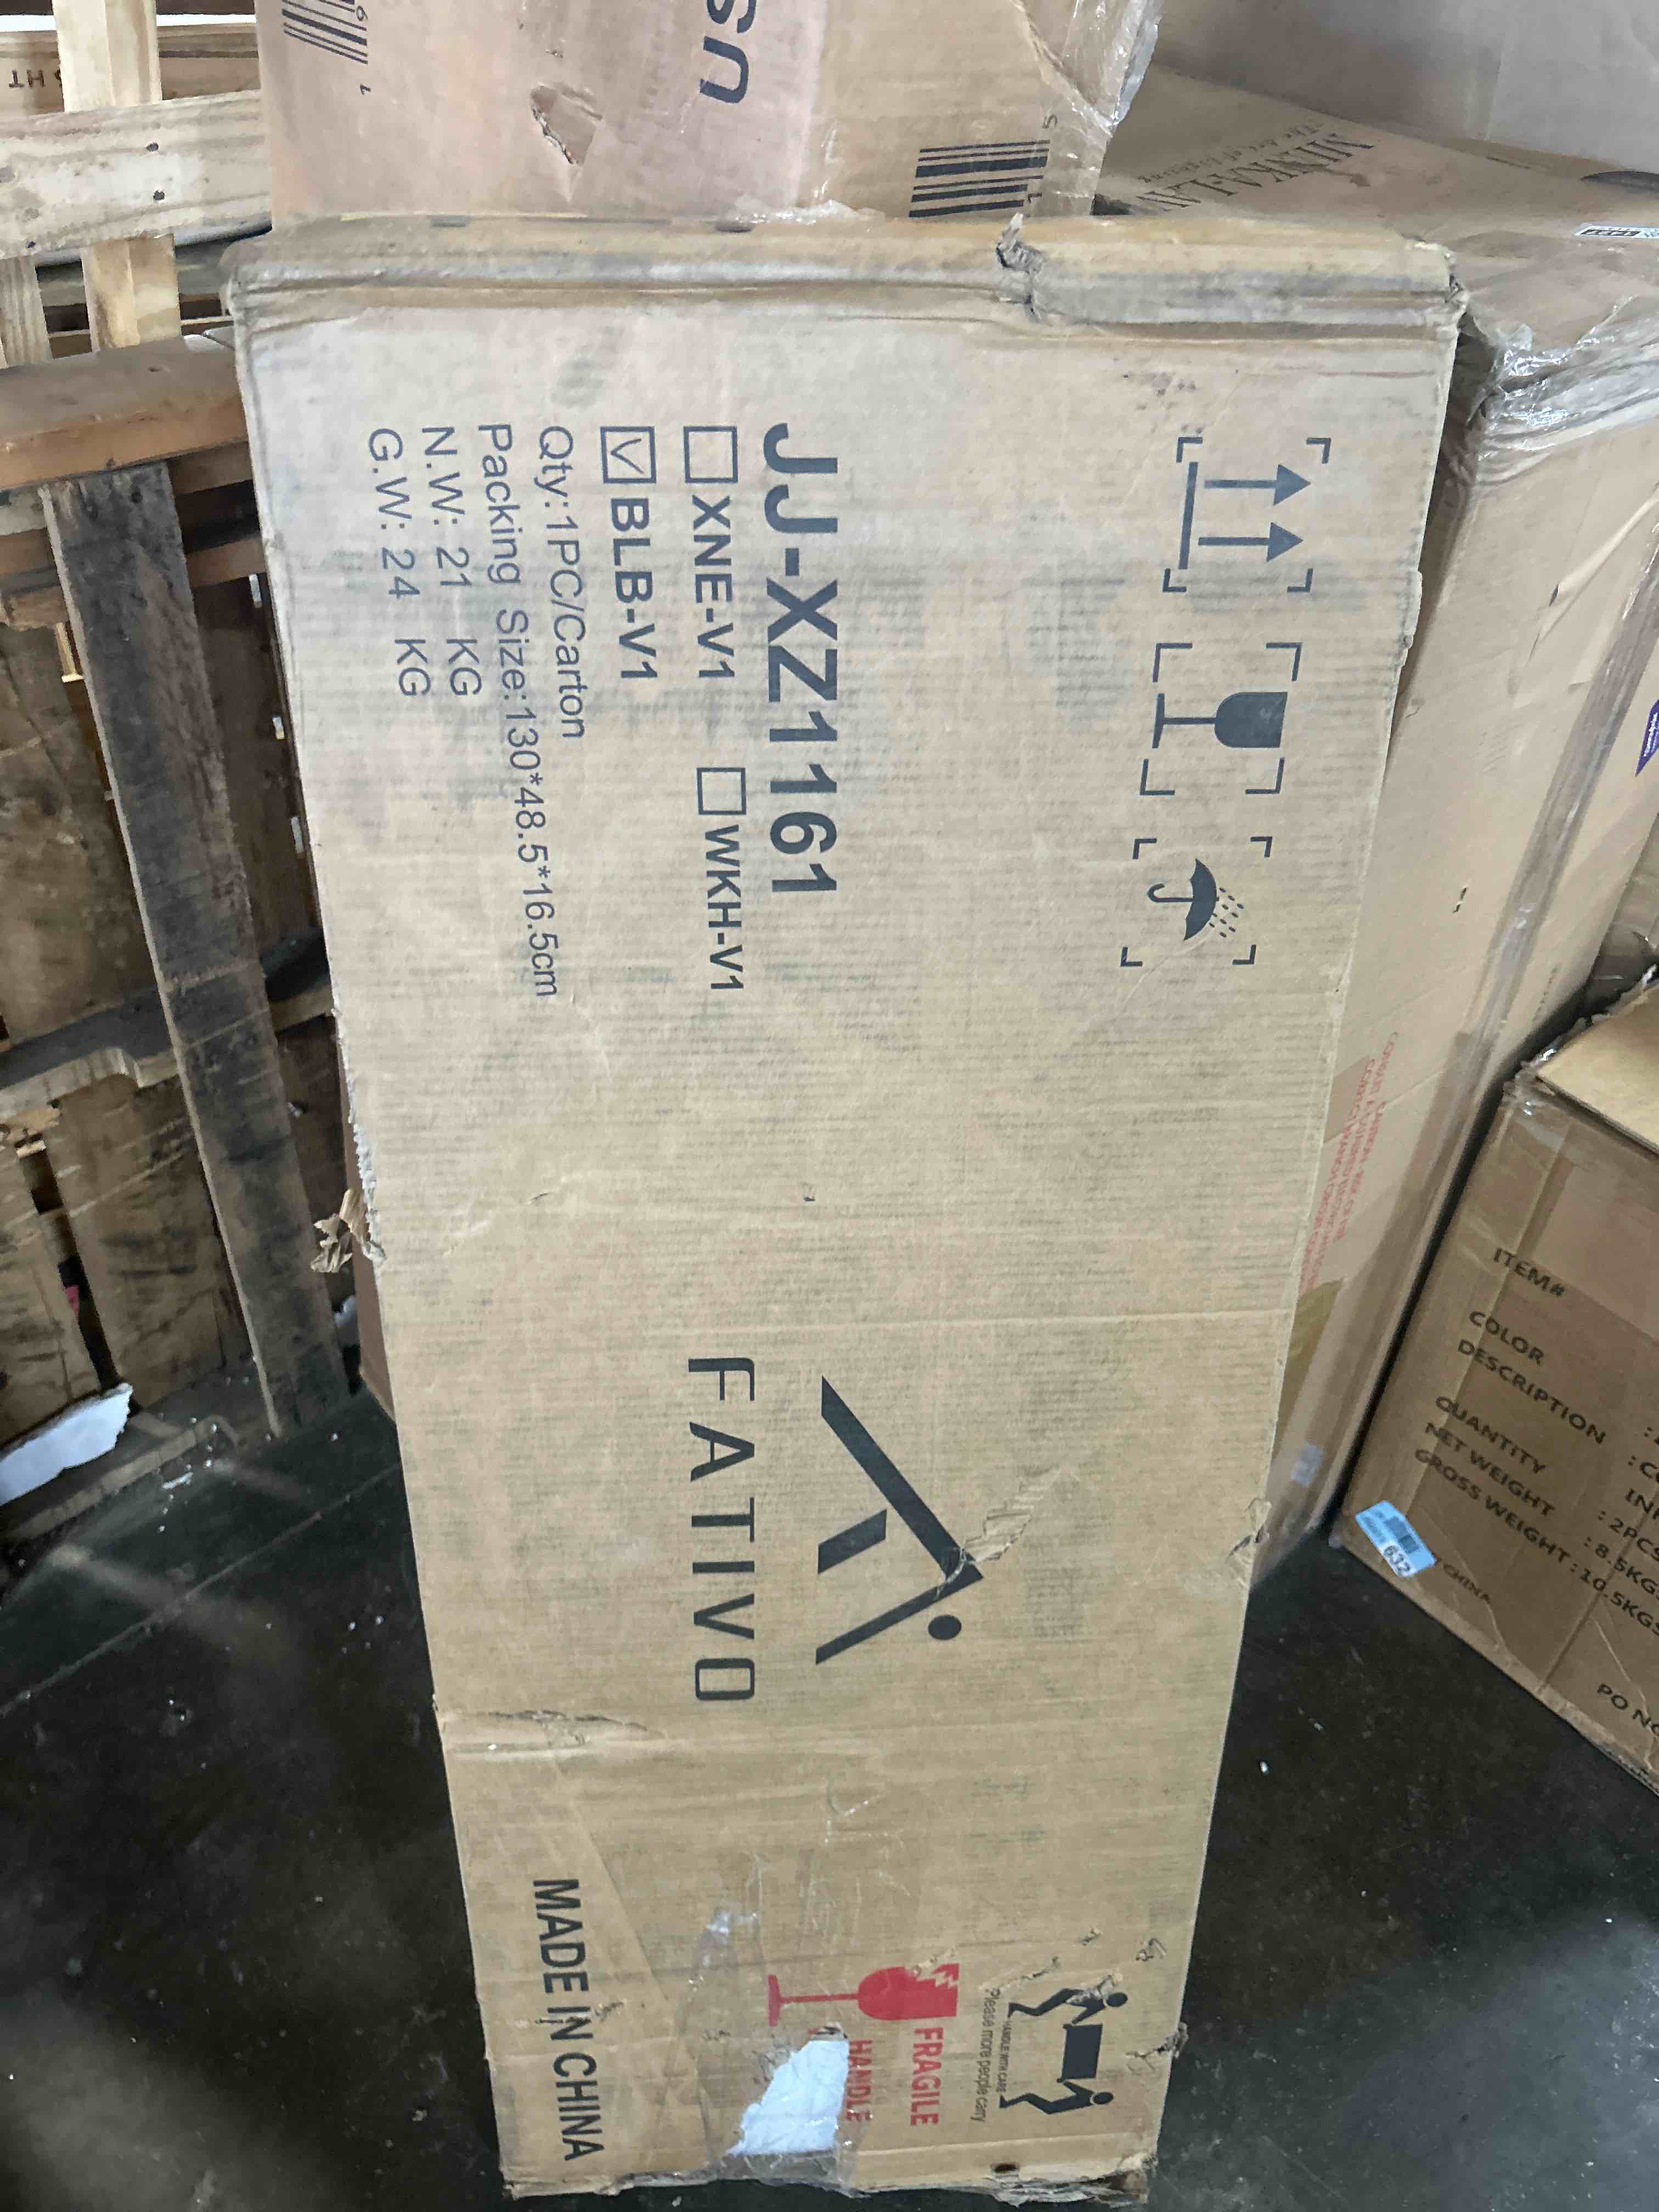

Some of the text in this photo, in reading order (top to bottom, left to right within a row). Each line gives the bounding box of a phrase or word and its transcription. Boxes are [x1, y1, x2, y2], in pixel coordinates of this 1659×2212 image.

[478, 424, 523, 585] Packing
[369, 428, 431, 696] G.W: 24 KG
[422, 426, 482, 696] N.W: 21 KG
[611, 498, 658, 679] BLB-V1
[763, 422, 838, 892] JJ-XZ1161
[692, 494, 744, 990] XNE-V1 WKH-V1
[1493, 1247, 1567, 1298] ITEM#
[1468, 1310, 1546, 1367] COLOR
[1435, 1395, 1547, 1475] QUANTITY
[1457, 1338, 1606, 1445] DESCRIPTION
[1425, 1422, 1556, 1519] NET WEIGHT
[688, 1357, 755, 1700] FATIVO
[1384, 1544, 1411, 1574] 632
[1484, 1494, 1572, 1565] WEIGHT
[1597, 1683, 1628, 1710] PO
[533, 1878, 605, 2161] MADE IN CHINA
[980, 2029, 994, 2058] more
[847, 2039, 873, 2122] HANDLE
[910, 2027, 944, 2126] FRAGILE
[970, 2096, 988, 2122] carry
[973, 2060, 992, 2096] people
